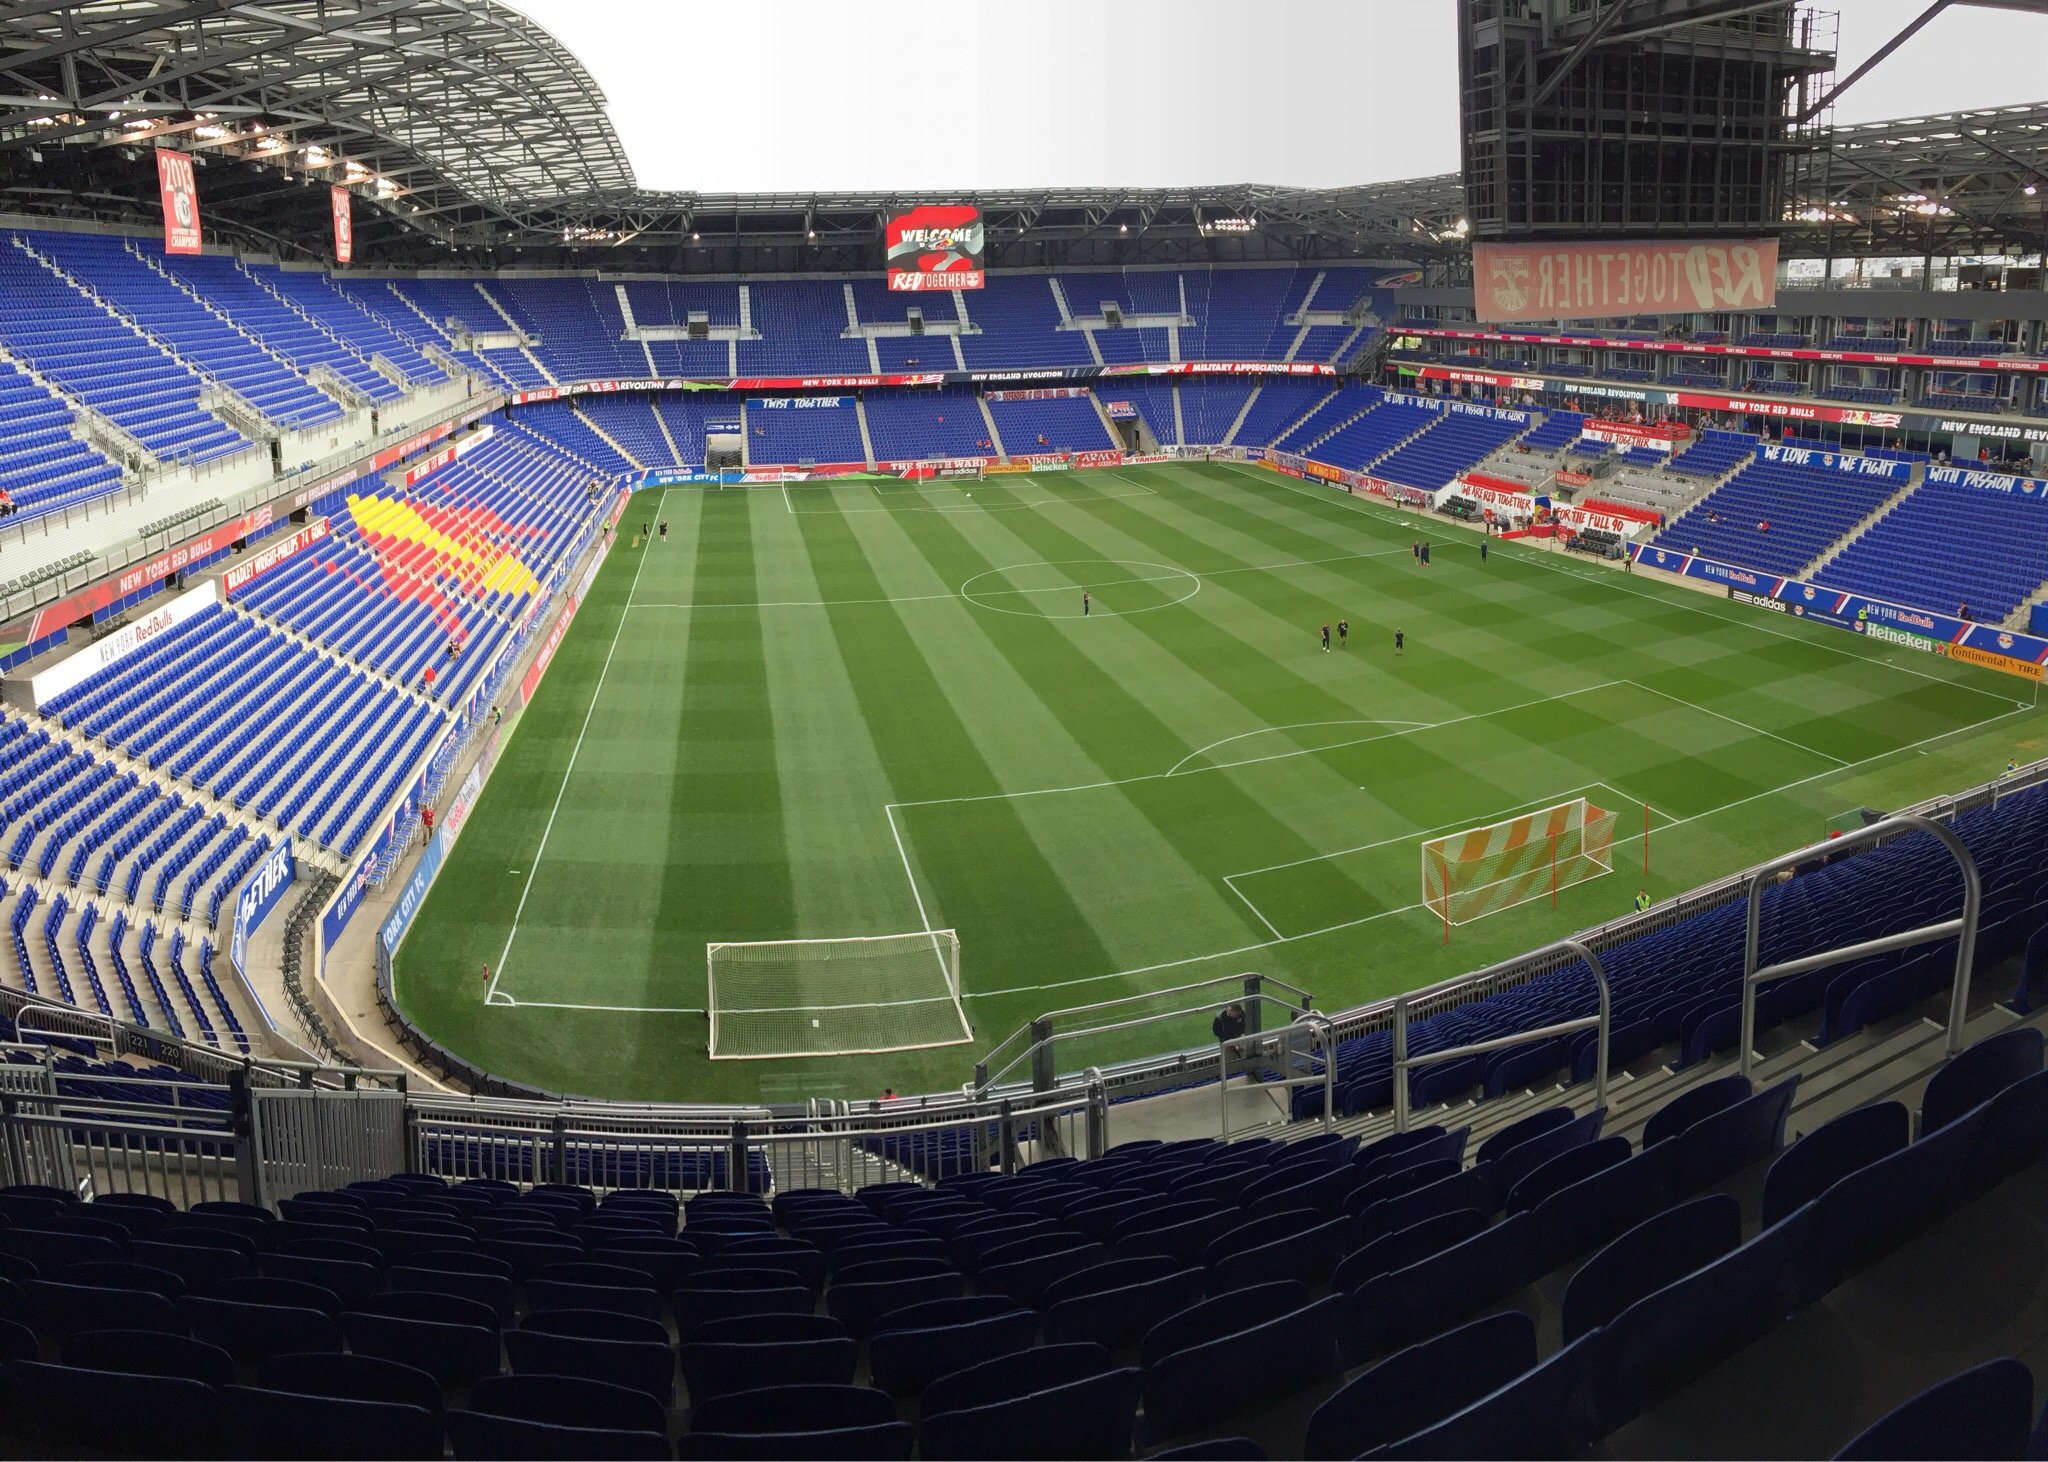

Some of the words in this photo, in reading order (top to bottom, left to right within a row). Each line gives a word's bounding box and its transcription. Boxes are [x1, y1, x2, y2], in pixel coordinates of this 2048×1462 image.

[162, 156, 194, 195] 2013
[901, 228, 972, 242] WELCOME
[893, 272, 922, 290] RED
[922, 272, 966, 287] TOGETHER
[1192, 364, 1232, 372] MILITARY
[989, 373, 1021, 381] ENGLAND
[1565, 384, 1578, 392] NEW
[1579, 385, 1607, 396] ENGLAND
[1608, 388, 1646, 400] REVOLUTION
[1666, 393, 1679, 404] VS
[762, 398, 787, 408] TWIST
[794, 397, 840, 408] TOGETHER
[1392, 394, 1405, 405] LOVE
[1416, 398, 1425, 408] WE
[1729, 400, 1747, 410] NEW
[1749, 402, 1770, 412] YORK
[1772, 405, 1788, 415] RED
[1790, 407, 1815, 418] BULLS
[1452, 404, 1464, 413] WITH
[1465, 405, 1484, 417] PASSION
[1495, 410, 1507, 421] FOR
[1508, 411, 1525, 423] GLORY
[1941, 421, 1966, 432] NEW
[1968, 424, 2021, 439] ENGLAND
[1601, 431, 1613, 442] RED
[1616, 434, 1650, 448] TOGETHER
[891, 463, 913, 471] THE
[954, 459, 988, 468] WARD
[1082, 451, 1119, 462] ARMY
[1135, 455, 1168, 463] YANMAR
[1765, 446, 1779, 460] WE
[1782, 448, 1812, 465] LOVE
[1839, 456, 1857, 471] WE
[1859, 458, 1897, 478] FIGHT
[954, 468, 978, 476] adidas
[1307, 462, 1329, 477] VIKING
[1929, 467, 1959, 484] WITH
[1963, 470, 2015, 492] PASSION
[295, 491, 308, 507] NEW
[1462, 485, 1472, 496] WE
[1472, 486, 1484, 499] ARE
[1484, 489, 1496, 502] RED
[1497, 493, 1532, 510] TOGETHER
[1556, 507, 1570, 520] FOR
[1572, 508, 1587, 524] THE
[1588, 512, 1610, 530] FULL
[1611, 518, 1624, 532] 90
[120, 573, 142, 593] NEW
[145, 557, 170, 581] YORK
[172, 549, 188, 569] RED
[190, 538, 213, 559] BULLS
[227, 564, 254, 592] BRADLEY
[255, 541, 299, 575] WRIGHT-PHILLIPS
[301, 533, 310, 548] 74
[311, 524, 327, 543] GOALS
[1705, 564, 1715, 575] NEW
[1716, 566, 1729, 579] YORK
[1753, 595, 1786, 612] adidas
[1866, 603, 1880, 616] NEW
[1881, 606, 1898, 620] YORK
[1866, 622, 1933, 652] Heineken
[100, 645, 115, 665] NEW
[117, 632, 134, 654] YORK
[1952, 645, 2007, 668] Continental
[2018, 663, 2041, 677] TIRE
[401, 885, 416, 918] CITY
[414, 872, 425, 894] FC
